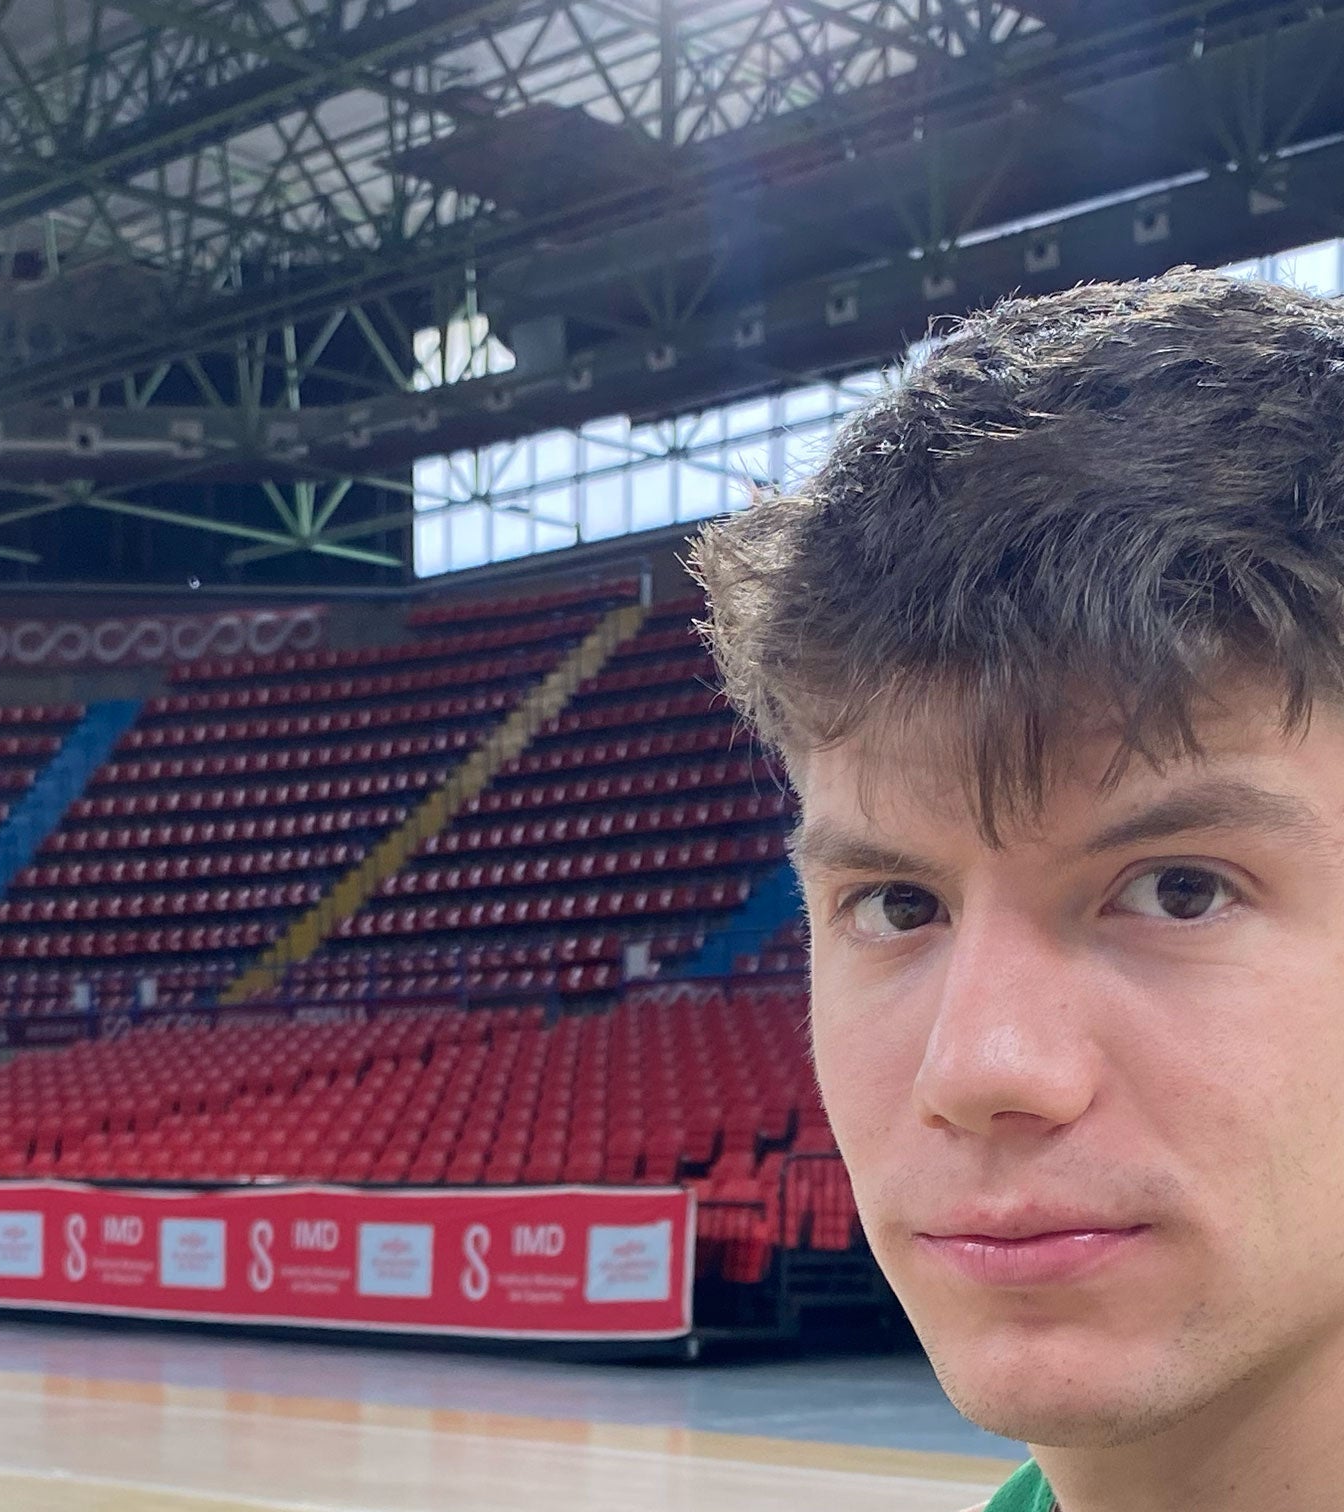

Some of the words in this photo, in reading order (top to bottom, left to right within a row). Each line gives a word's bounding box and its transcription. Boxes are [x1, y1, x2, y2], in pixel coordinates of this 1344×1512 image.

[102, 1215, 144, 1246] IMD
[293, 1219, 340, 1251] IMD
[513, 1225, 565, 1257] IMD
